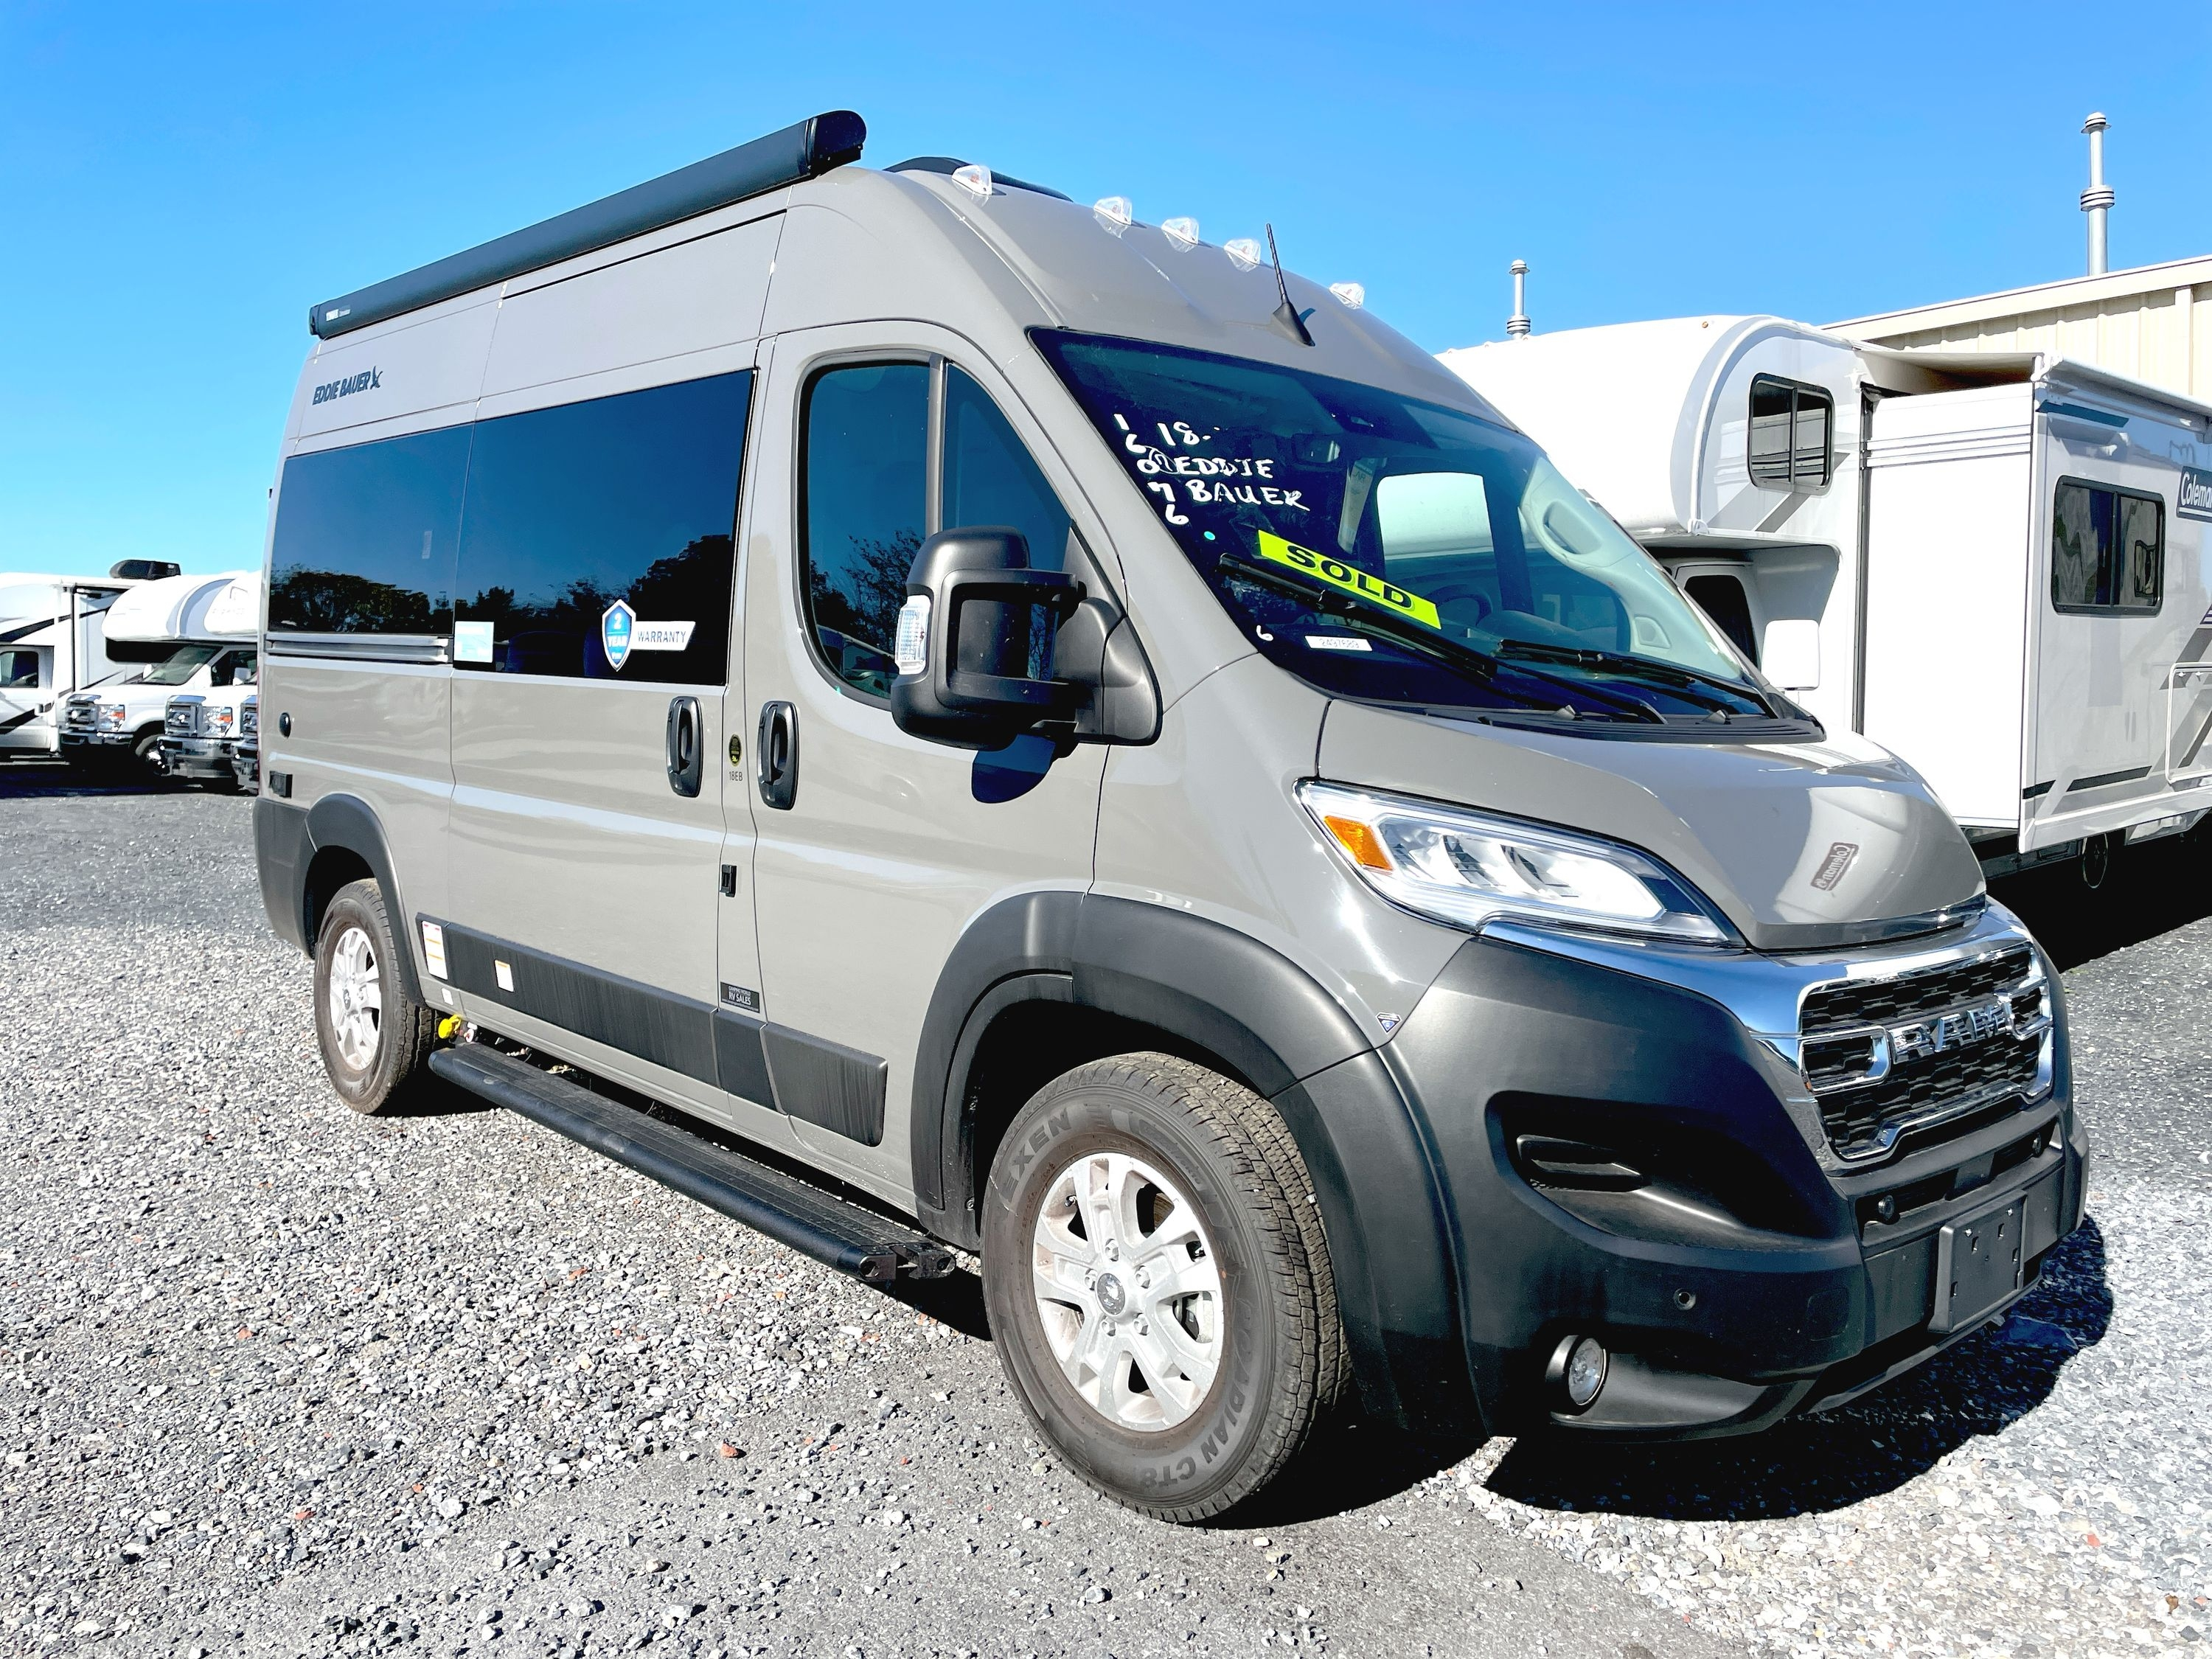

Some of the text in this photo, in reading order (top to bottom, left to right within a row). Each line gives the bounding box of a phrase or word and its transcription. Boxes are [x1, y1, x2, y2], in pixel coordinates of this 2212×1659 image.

[313, 371, 371, 406] EDDIE BAUER
[1174, 456, 1274, 479] EDDIE
[1185, 479, 1310, 511] BAUER
[2180, 471, 2212, 509] Colema
[1286, 545, 1413, 610] SOLD
[613, 612, 623, 630] 2
[637, 630, 686, 643] WARRANTY
[728, 771, 743, 782] 18EB
[728, 991, 736, 1001] RV
[736, 993, 751, 1006] SALES
[1888, 1001, 2008, 1065] RAM
